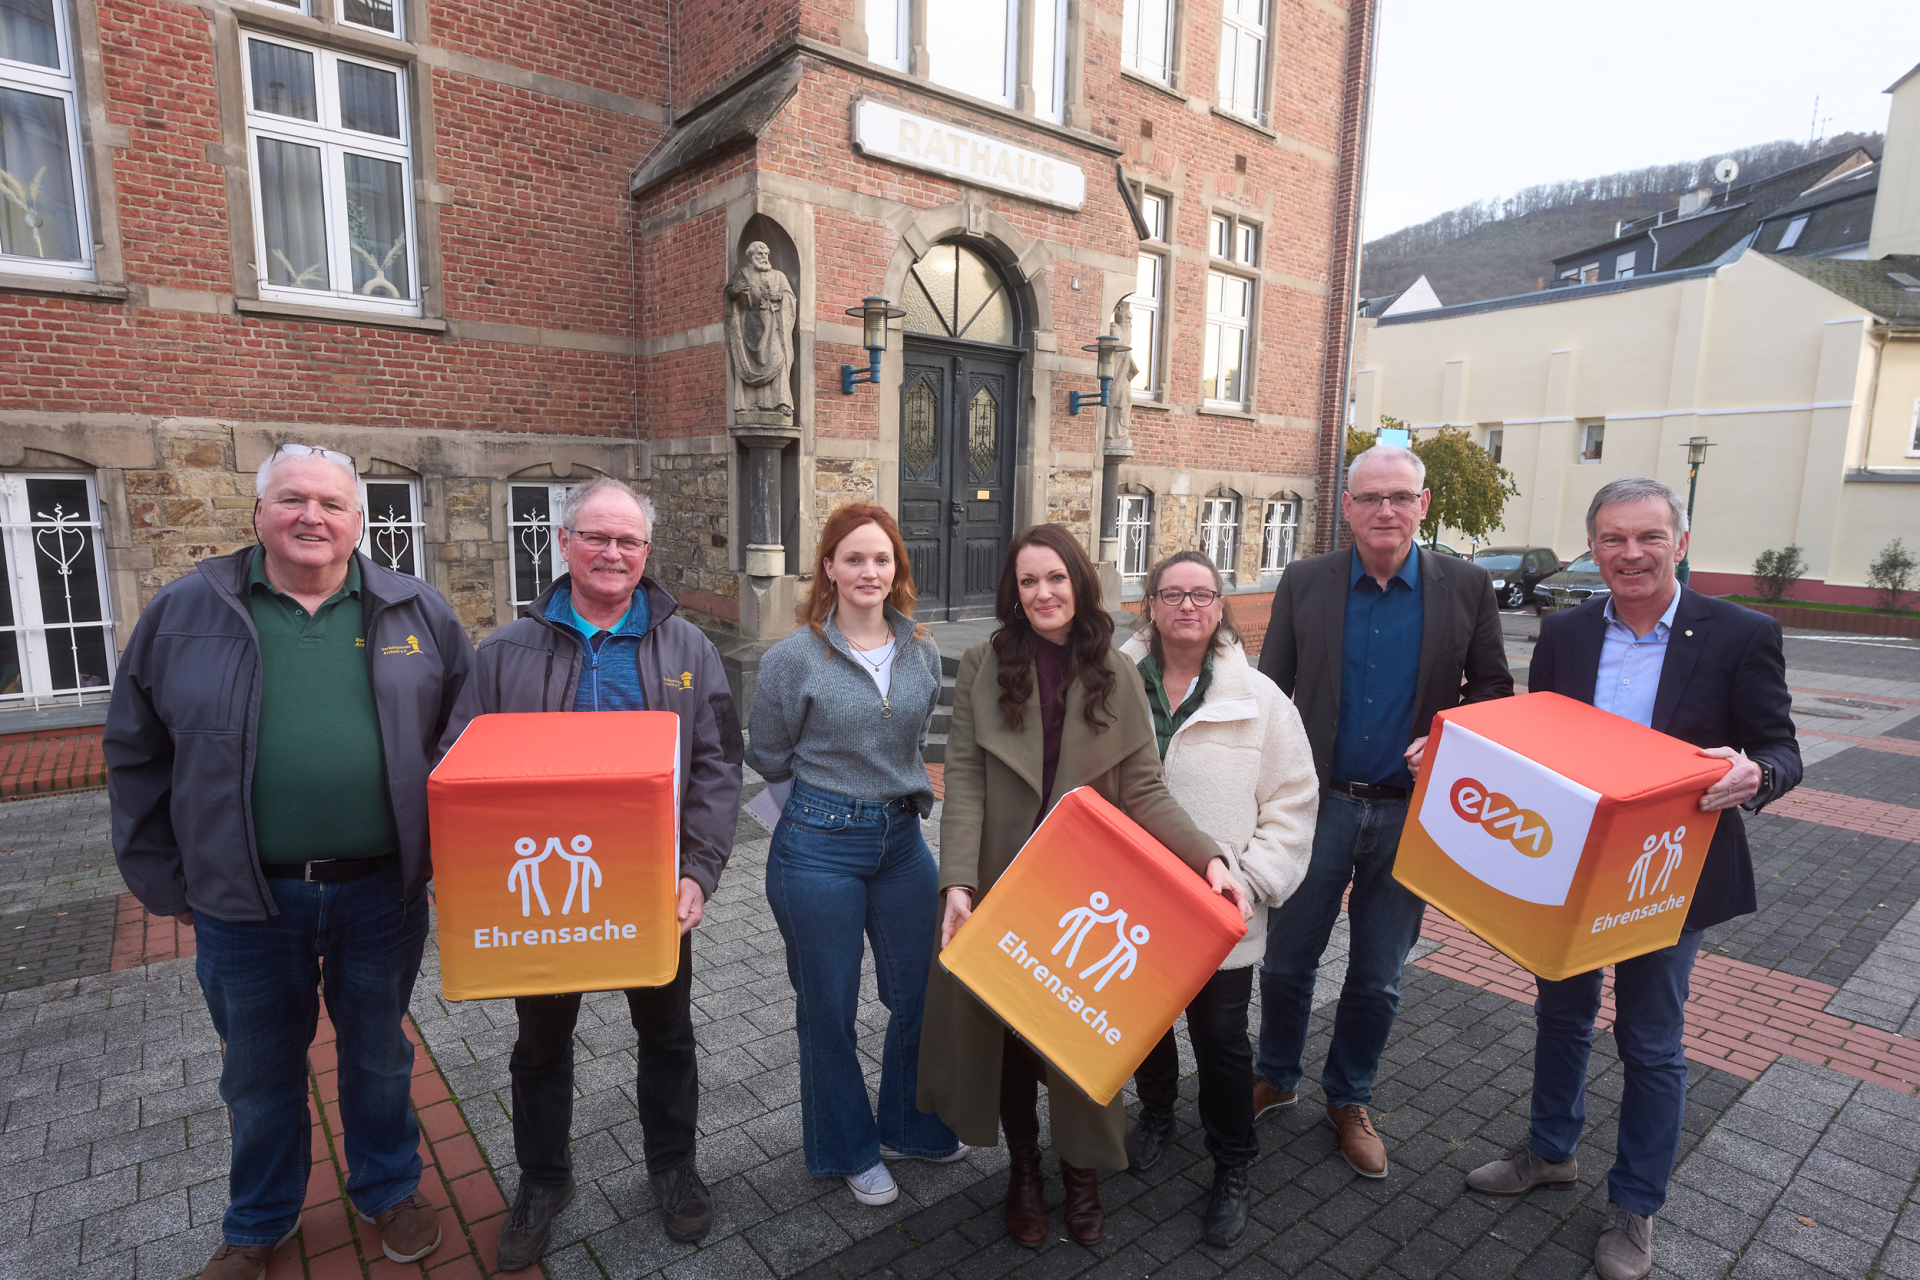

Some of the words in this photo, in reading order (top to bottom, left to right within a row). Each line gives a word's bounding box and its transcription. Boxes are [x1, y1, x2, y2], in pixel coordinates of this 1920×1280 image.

[898, 118, 1056, 194] RATHAUS
[474, 919, 637, 949] Ehrensache
[1590, 893, 1686, 934] Ehrensache
[997, 930, 1122, 1046] Ehrensache
